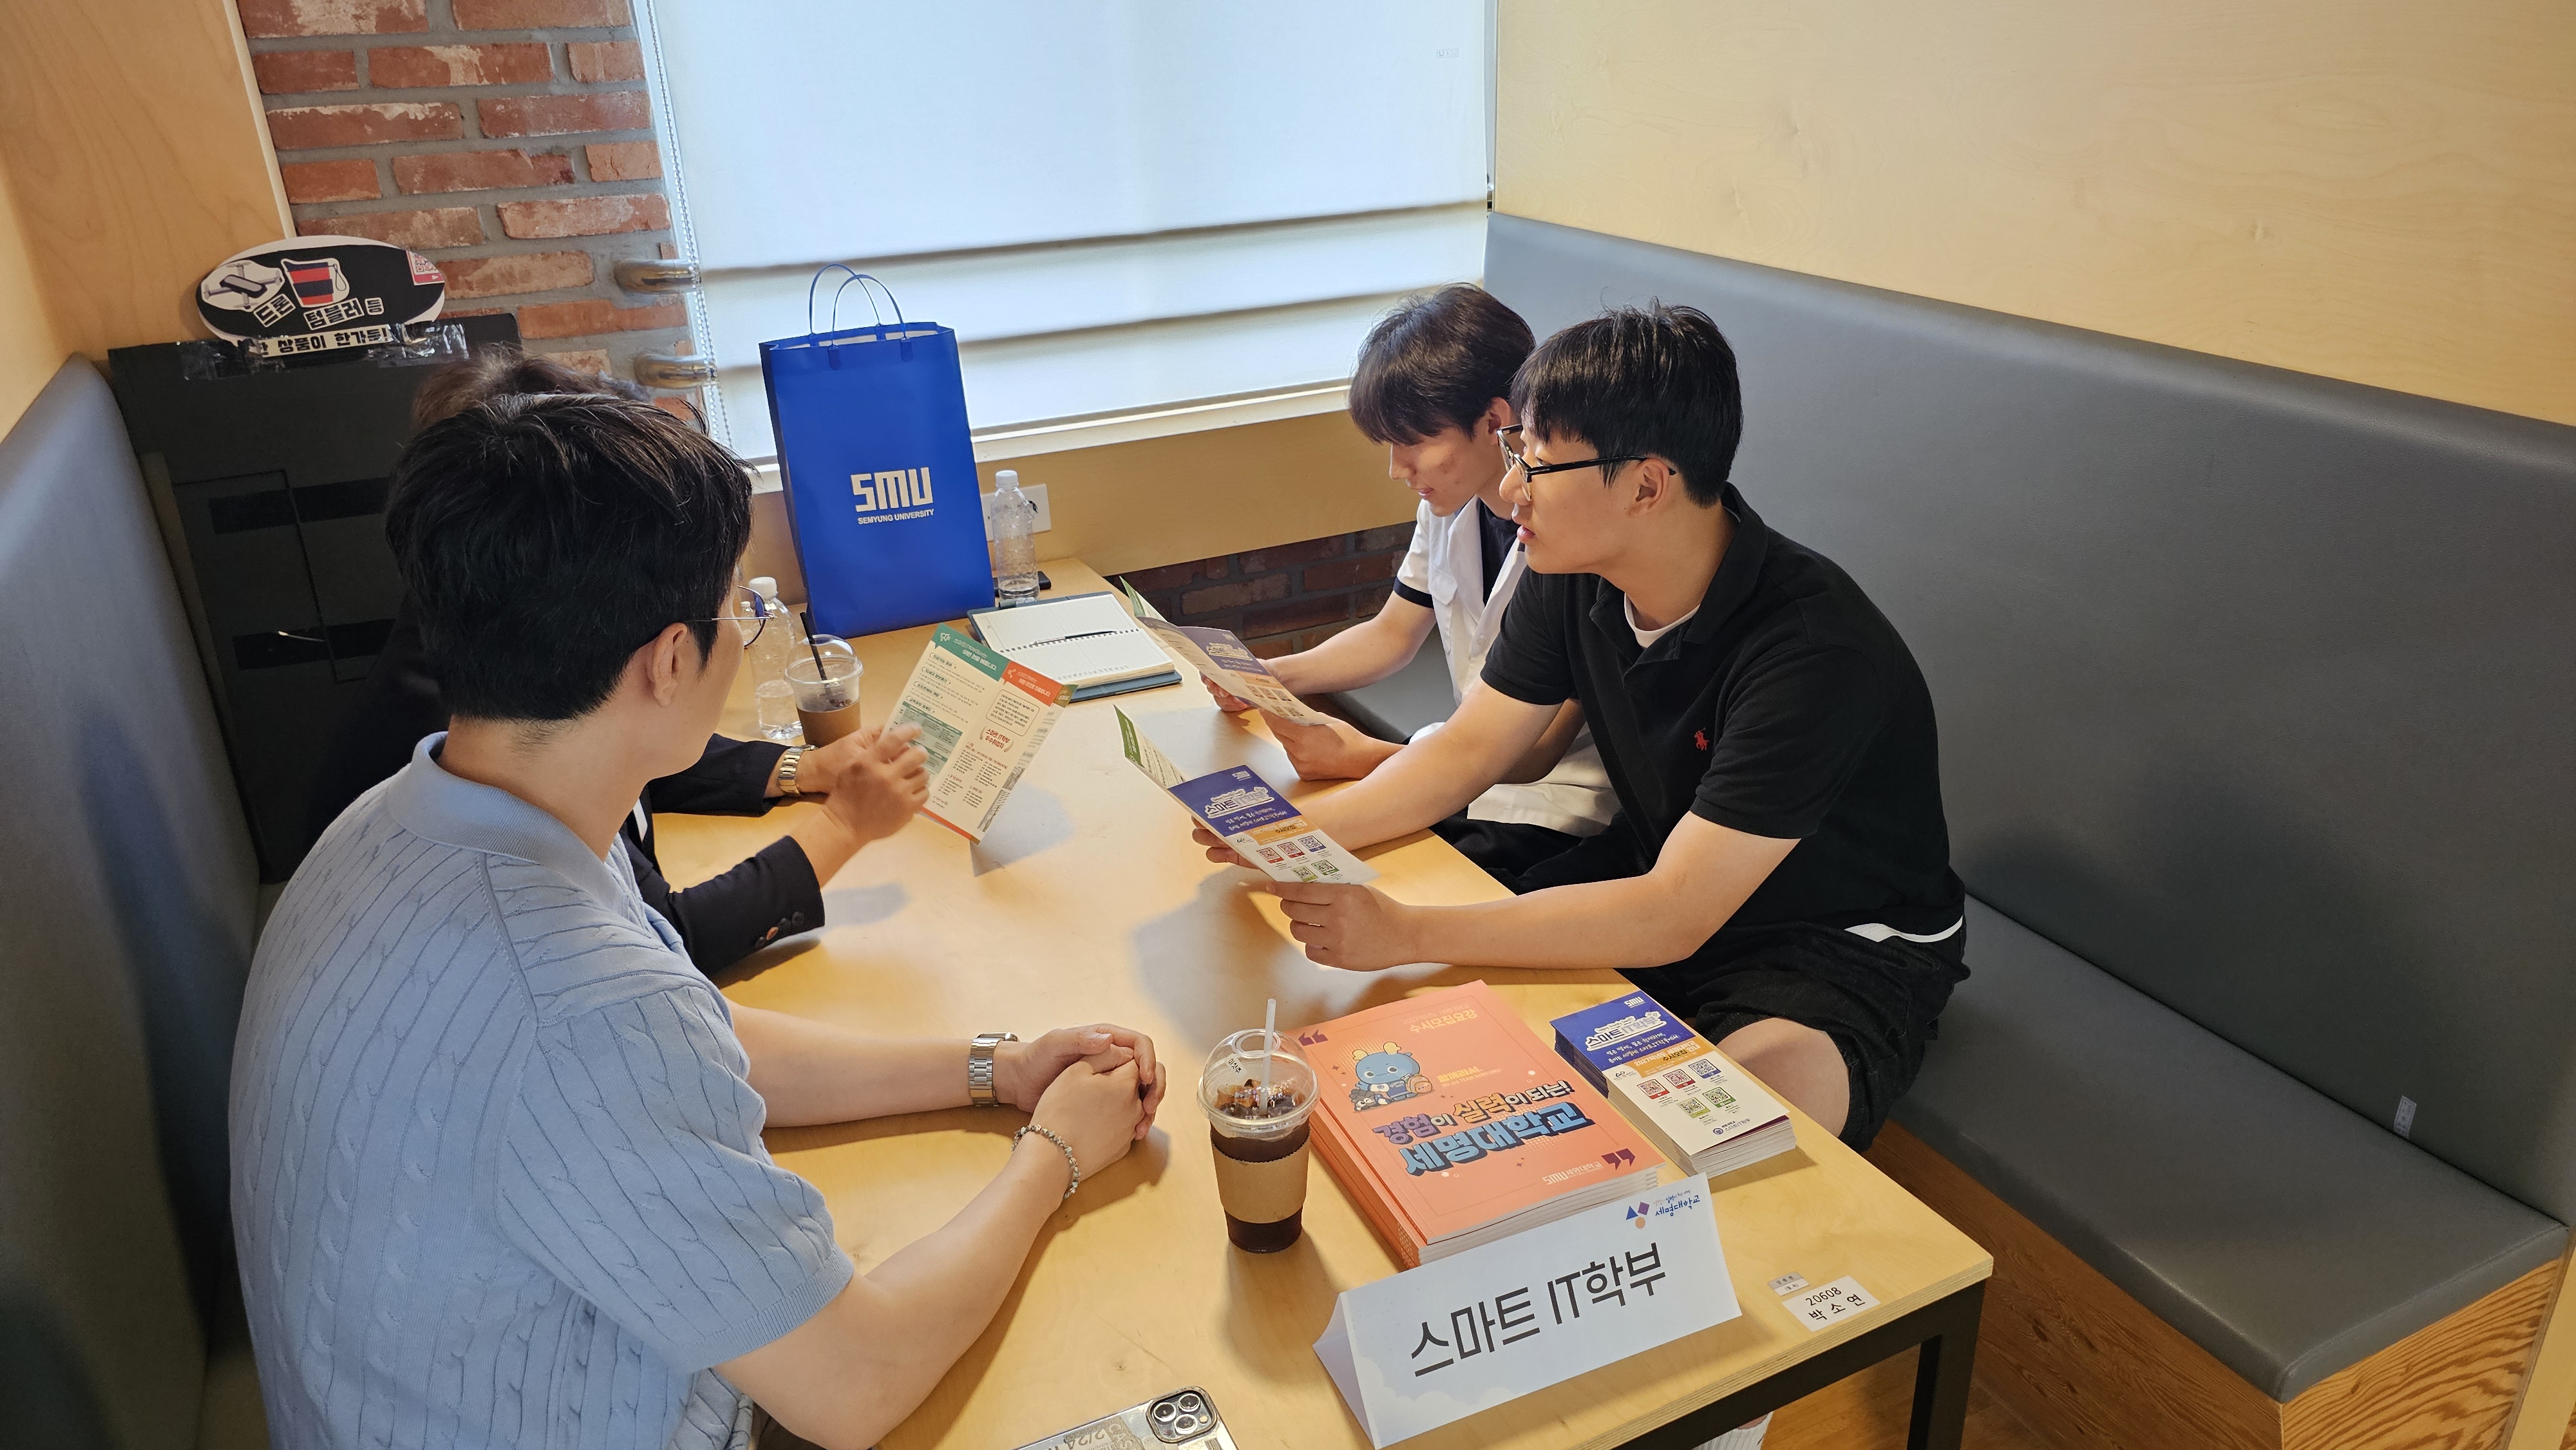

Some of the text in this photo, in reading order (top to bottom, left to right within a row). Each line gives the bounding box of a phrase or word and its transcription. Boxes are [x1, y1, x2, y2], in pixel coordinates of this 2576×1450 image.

[259, 295, 383, 330] 드론 텀블러 등
[278, 335, 327, 353] 상품이
[334, 327, 389, 346] 한가득!
[851, 467, 934, 513] SMU
[858, 509, 934, 525] SEMYUNG UNIVERSITY
[1624, 996, 1644, 1008] SMU
[1409, 1008, 1478, 1033] 수시모집요강
[1587, 1015, 1658, 1047] 스마트IT학부
[1633, 1051, 1669, 1066] 2027학년도
[1662, 1049, 1688, 1061] 수시모집
[1372, 1080, 1575, 1145] 경험이 실력이 되는!
[1398, 1102, 1596, 1176] 세명대학교
[1541, 1171, 1569, 1185] SMU
[1566, 1161, 1602, 1175] 세명대학교
[1655, 1194, 1700, 1216] 세명대학교
[1411, 1241, 1666, 1377] 스마트 IT학부
[1805, 1287, 1842, 1306] 20608
[1808, 1294, 1866, 1320] 박 소 연
